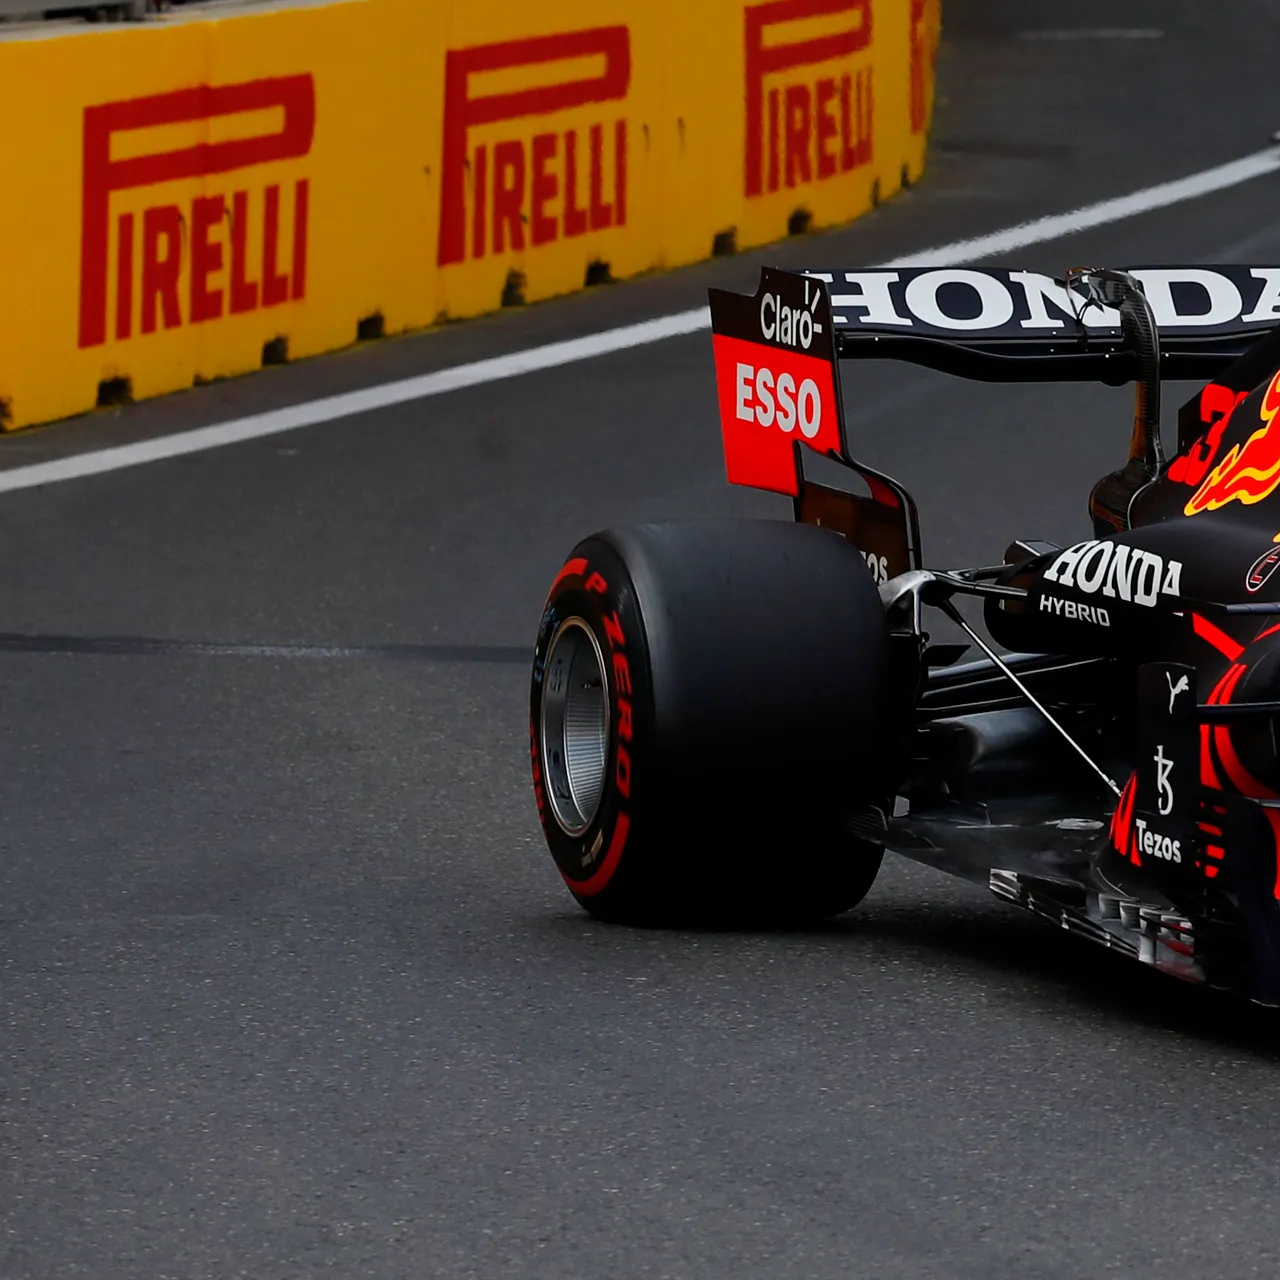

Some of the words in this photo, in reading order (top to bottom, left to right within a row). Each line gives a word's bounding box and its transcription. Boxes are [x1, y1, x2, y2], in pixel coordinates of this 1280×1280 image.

[437, 24, 632, 269] PIRELLI
[77, 72, 317, 351] PIRELLI
[735, 363, 822, 439] ESSO
[1039, 593, 1111, 628] HYBRID
[1044, 540, 1182, 608] HONDA
[603, 609, 634, 800] ZERO
[1135, 818, 1182, 864] Tezos
